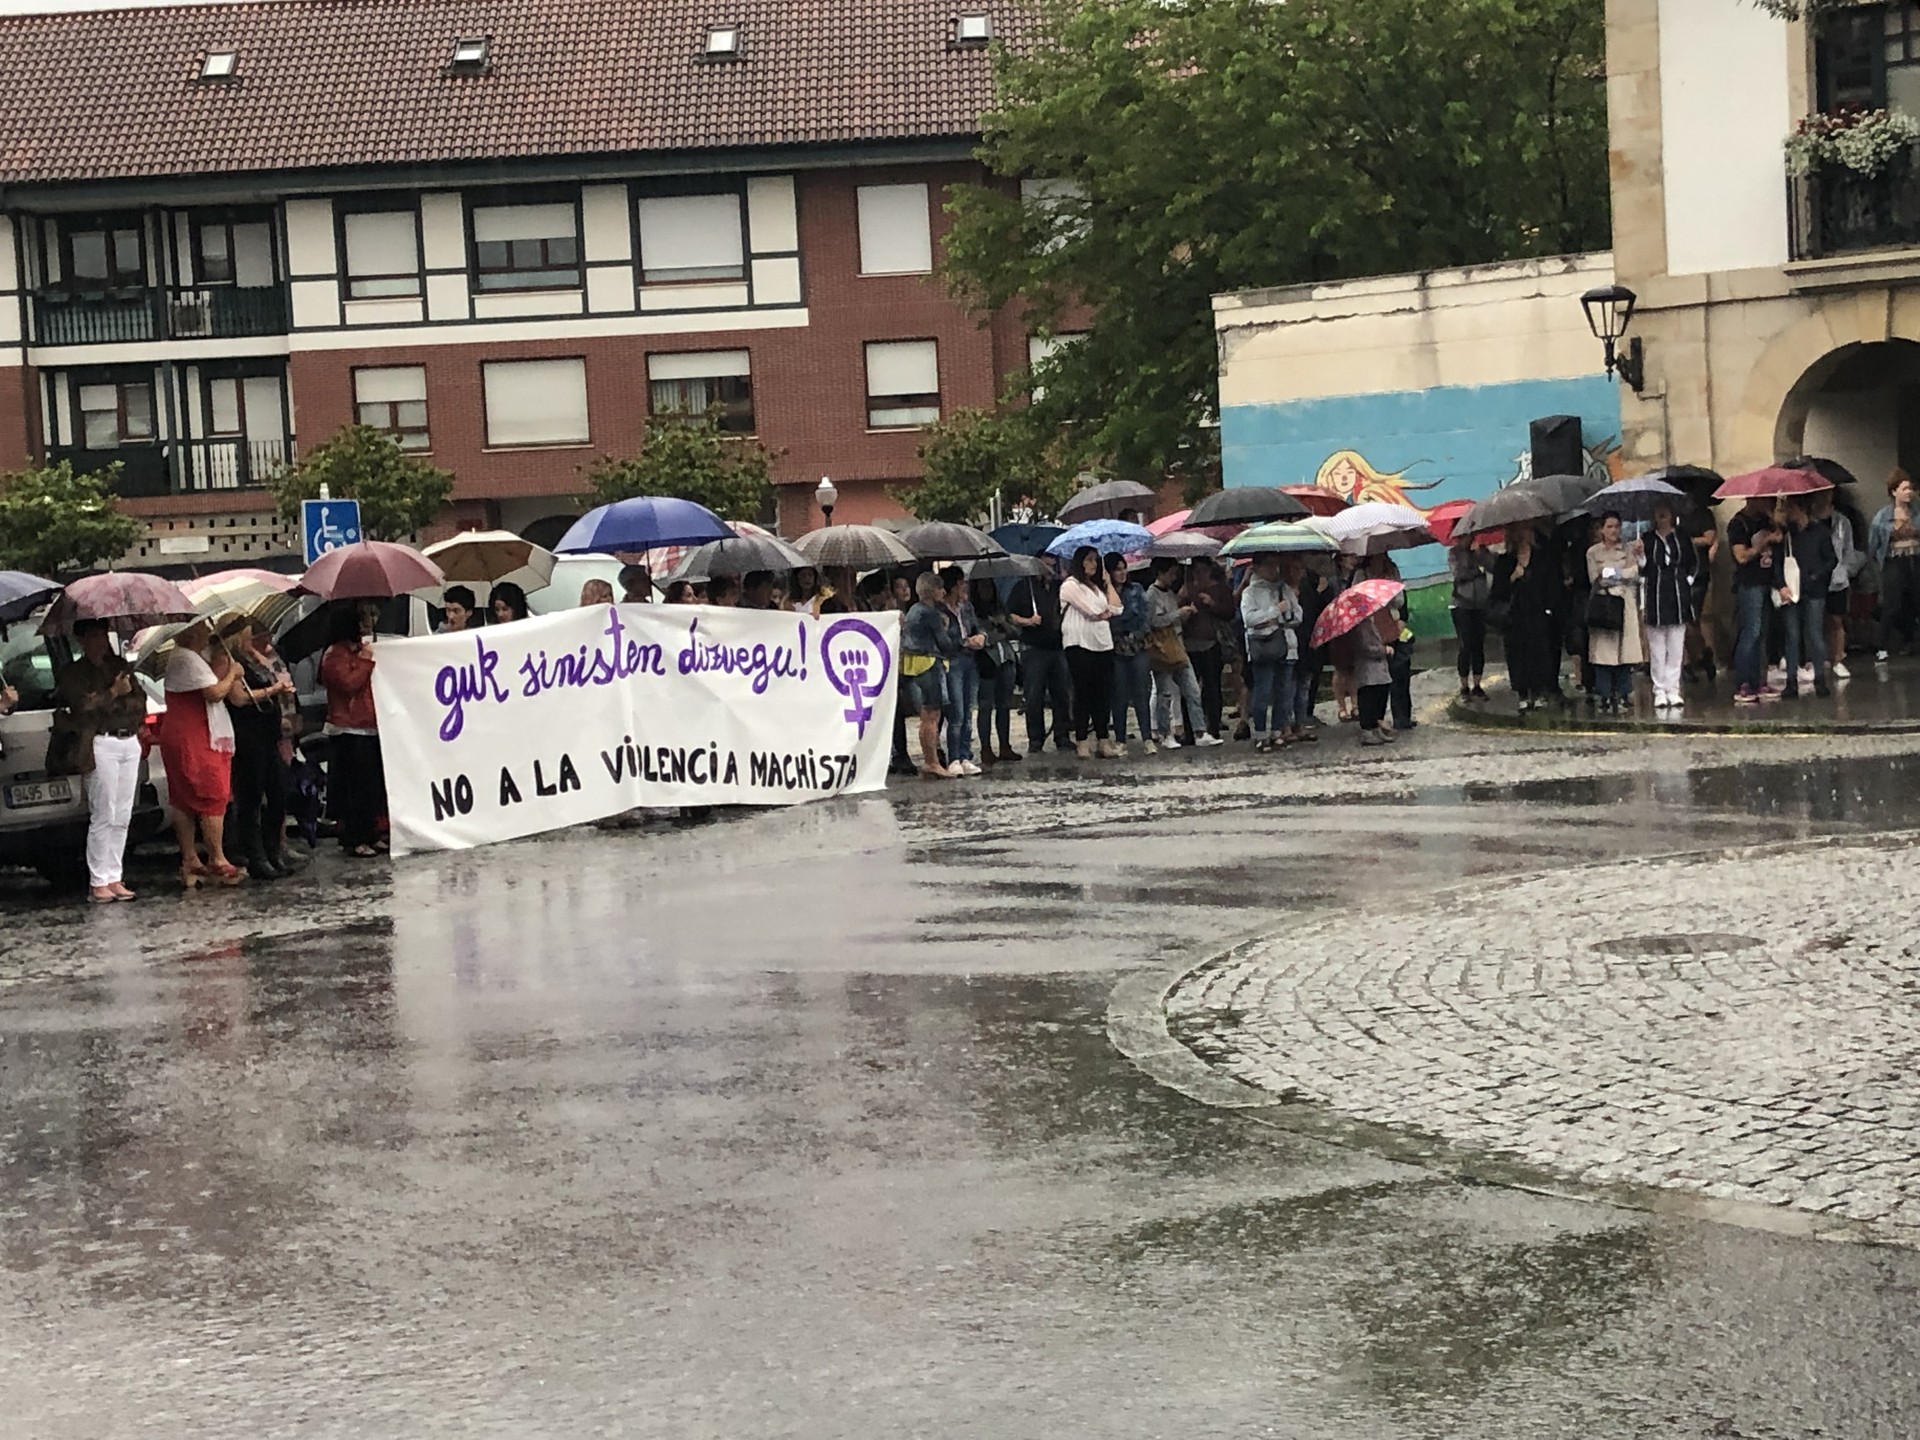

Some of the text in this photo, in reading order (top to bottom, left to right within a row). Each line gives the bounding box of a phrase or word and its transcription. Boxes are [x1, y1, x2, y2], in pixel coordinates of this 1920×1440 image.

[435, 634, 509, 742] guk
[430, 773, 474, 821] NO
[499, 766, 522, 806] A
[534, 753, 581, 796] LA
